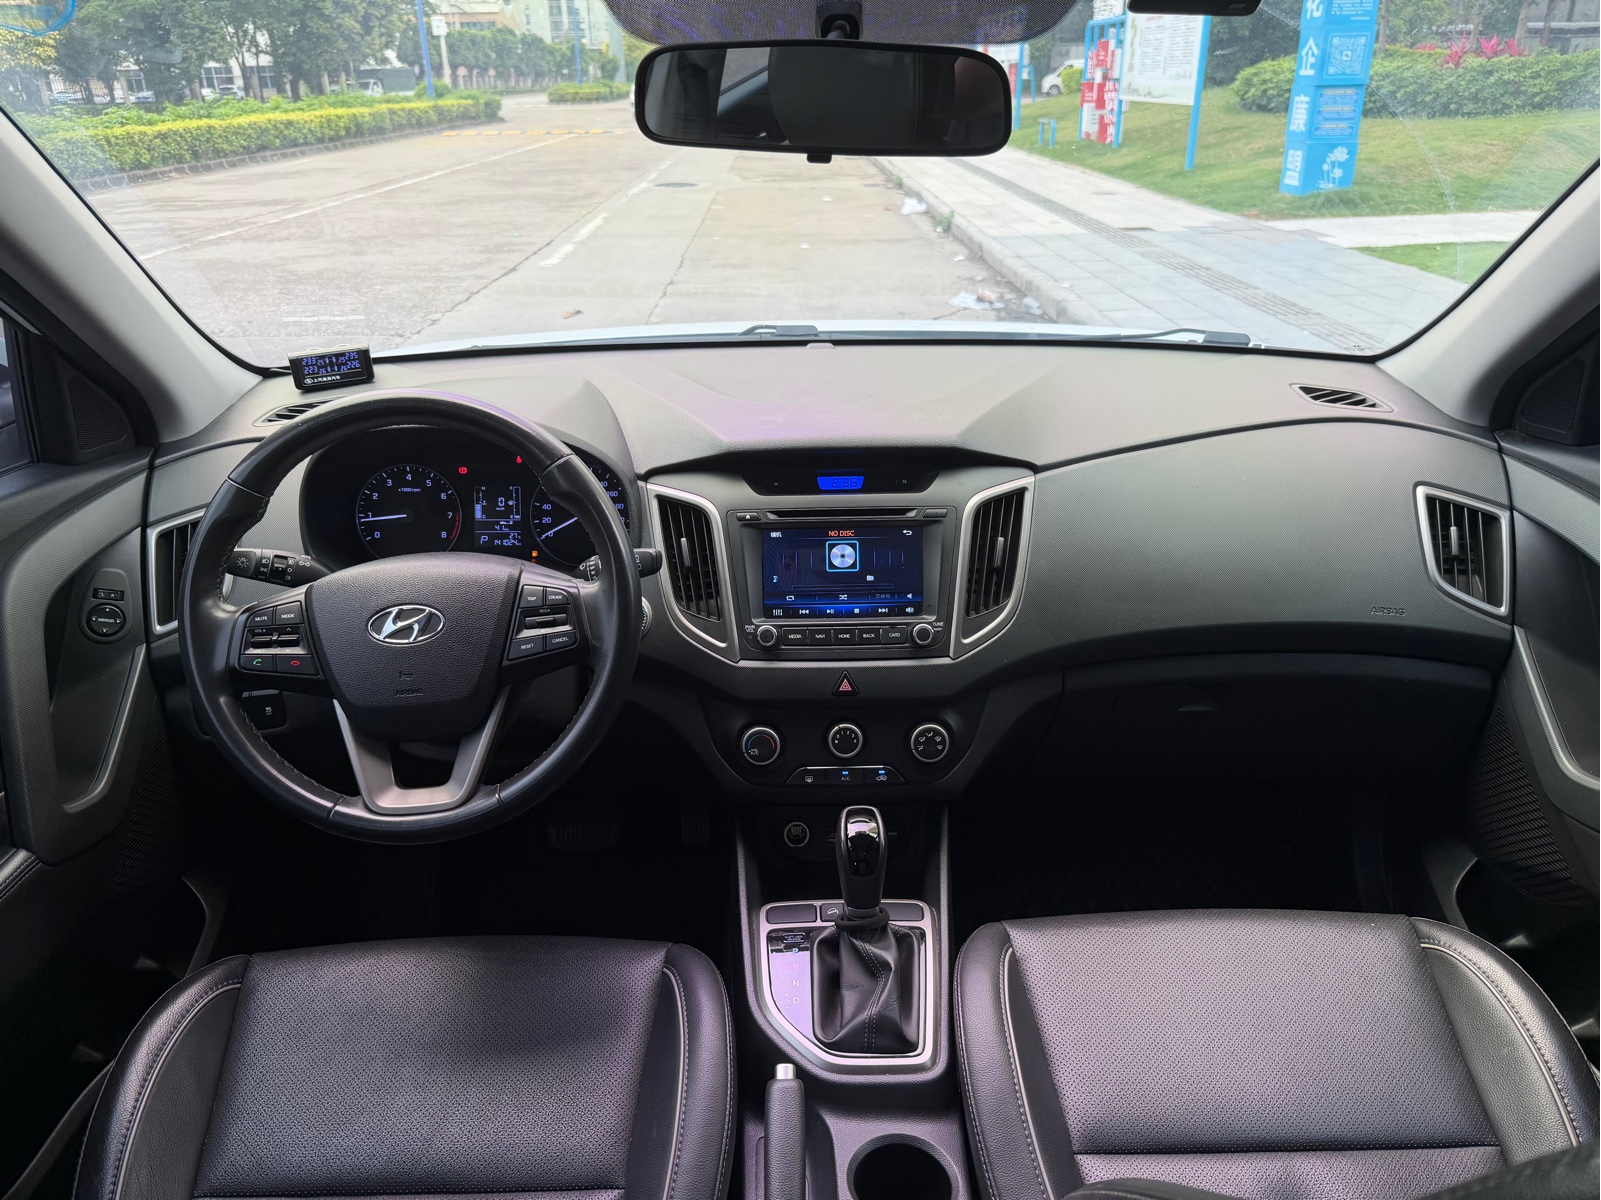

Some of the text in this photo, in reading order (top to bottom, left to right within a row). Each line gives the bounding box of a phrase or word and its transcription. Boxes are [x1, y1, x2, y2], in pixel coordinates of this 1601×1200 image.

[302, 357, 316, 365] 233
[304, 366, 318, 374] 223
[498, 497, 505, 506] 0
[480, 536, 488, 544] P
[1371, 606, 1405, 616] AIRBAG
